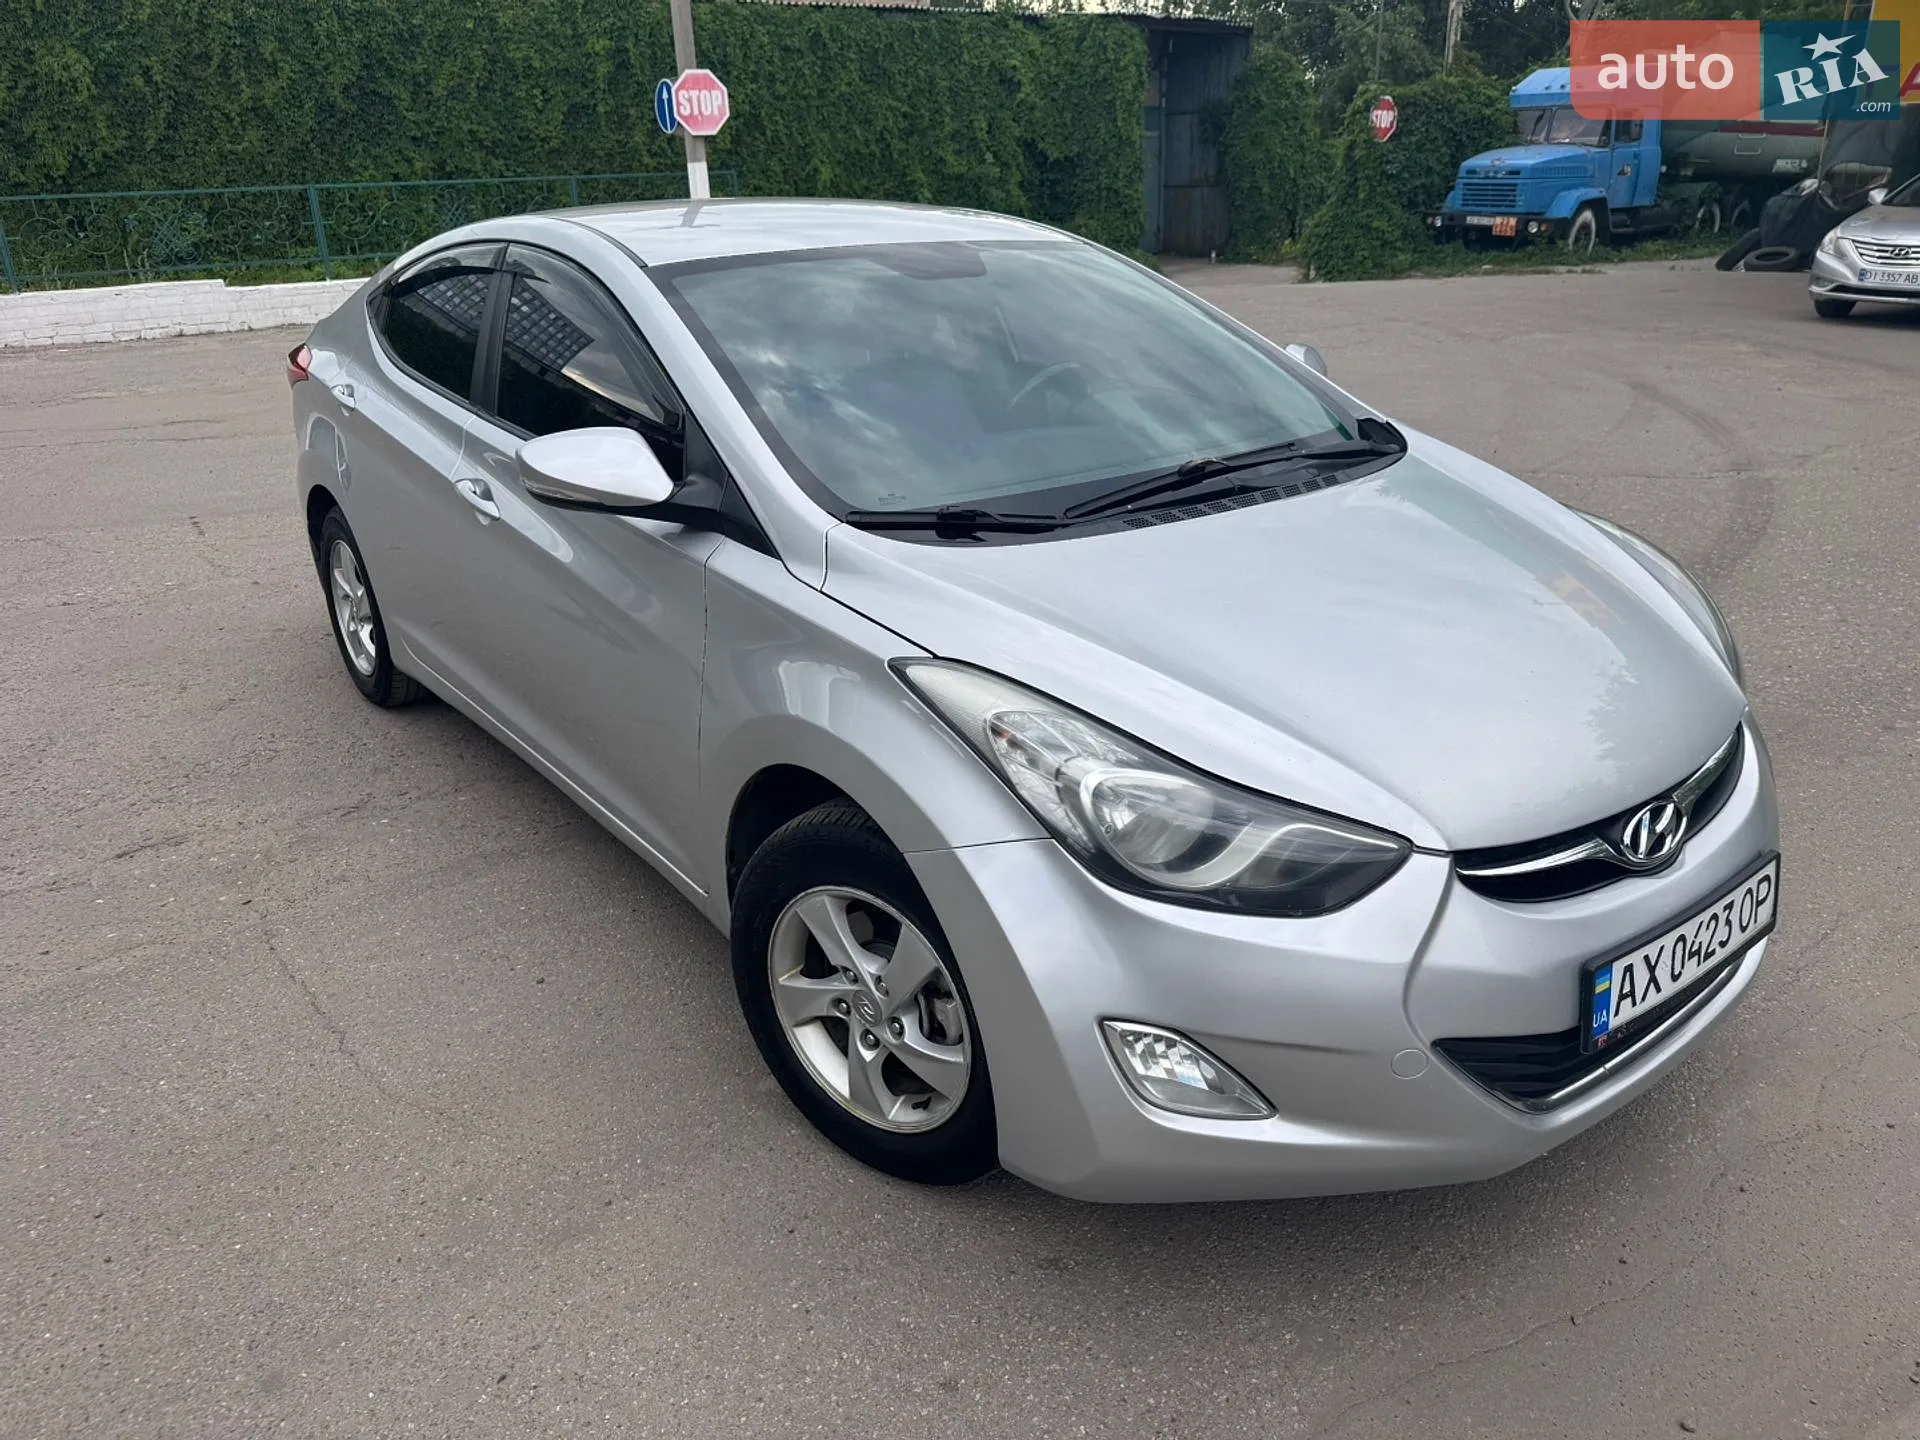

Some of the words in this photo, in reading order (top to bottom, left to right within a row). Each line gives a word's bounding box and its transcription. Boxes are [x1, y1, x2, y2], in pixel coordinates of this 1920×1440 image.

[678, 89, 722, 116] STOP
[1371, 109, 1395, 128] STOP
[1613, 944, 1665, 1018] AX
[1670, 899, 1735, 983] 0423
[1738, 873, 1772, 934] OP
[1592, 1009, 1608, 1028] UA
